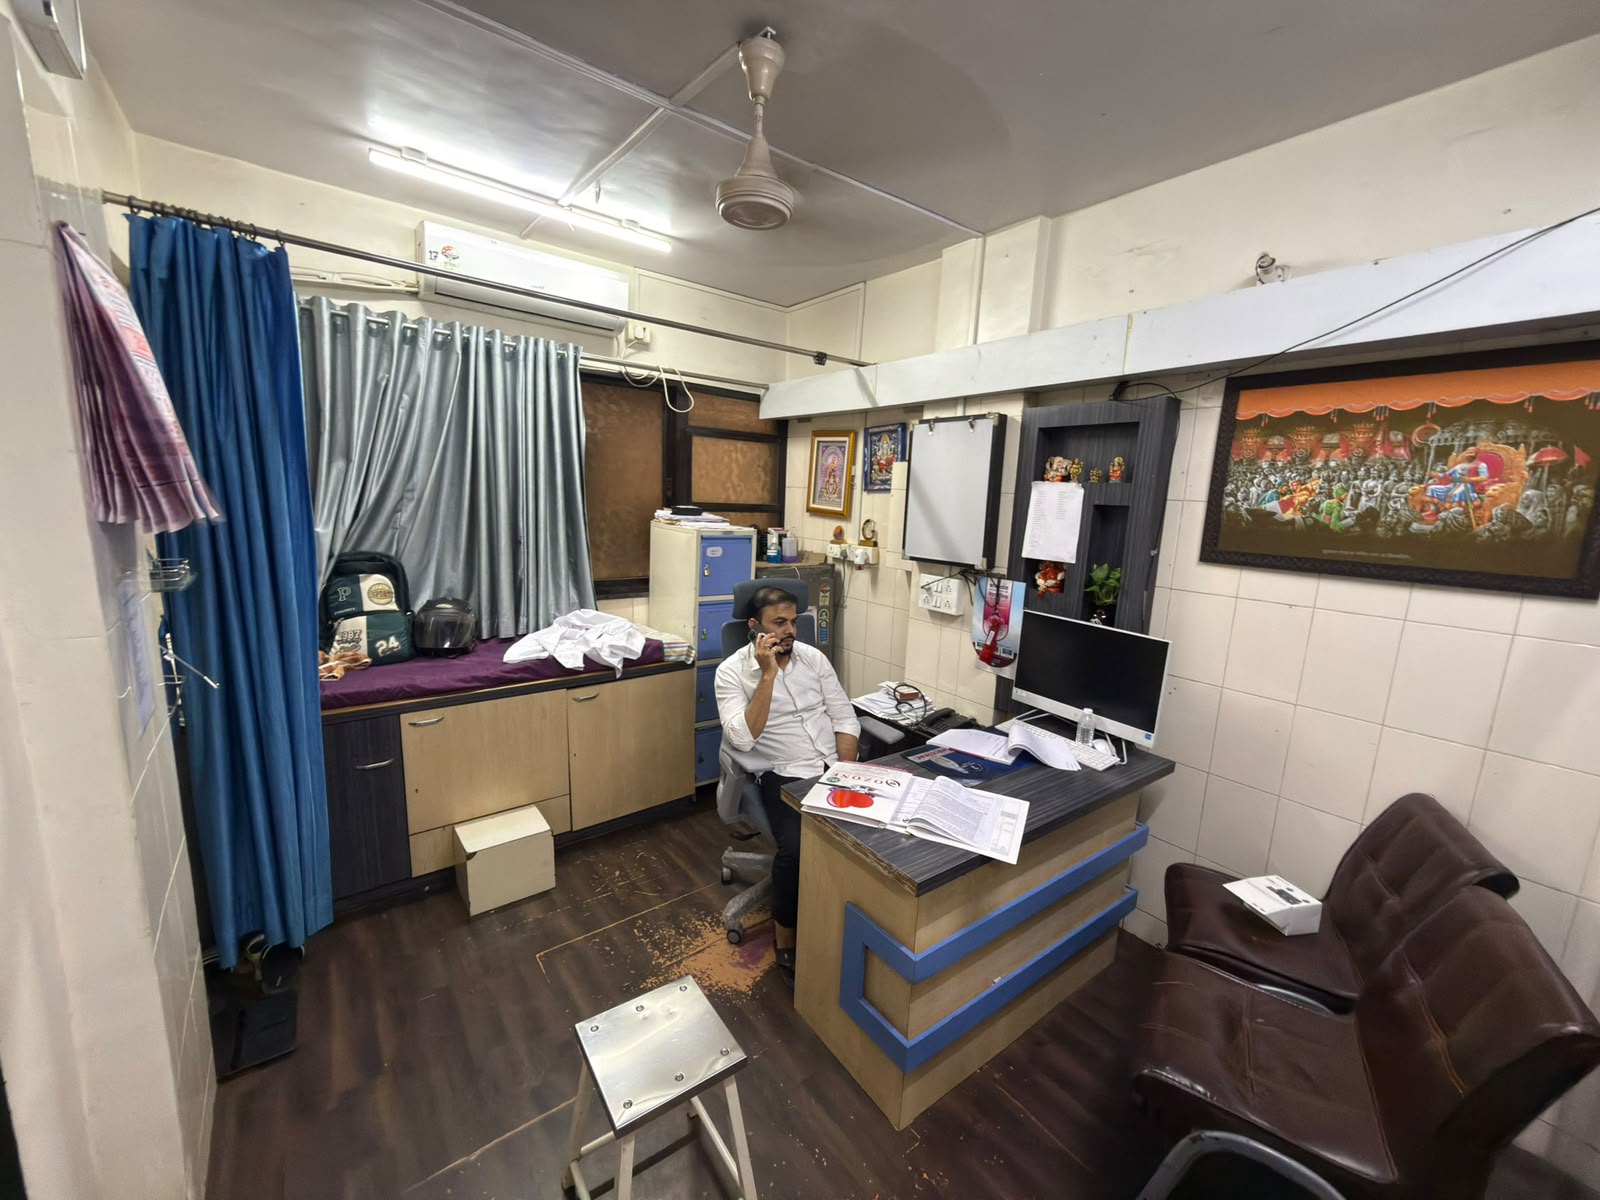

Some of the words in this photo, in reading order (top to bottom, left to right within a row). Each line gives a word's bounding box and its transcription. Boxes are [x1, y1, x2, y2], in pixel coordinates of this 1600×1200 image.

[337, 587, 352, 602] P
[375, 635, 401, 657] 24
[833, 772, 884, 785] OZONE
